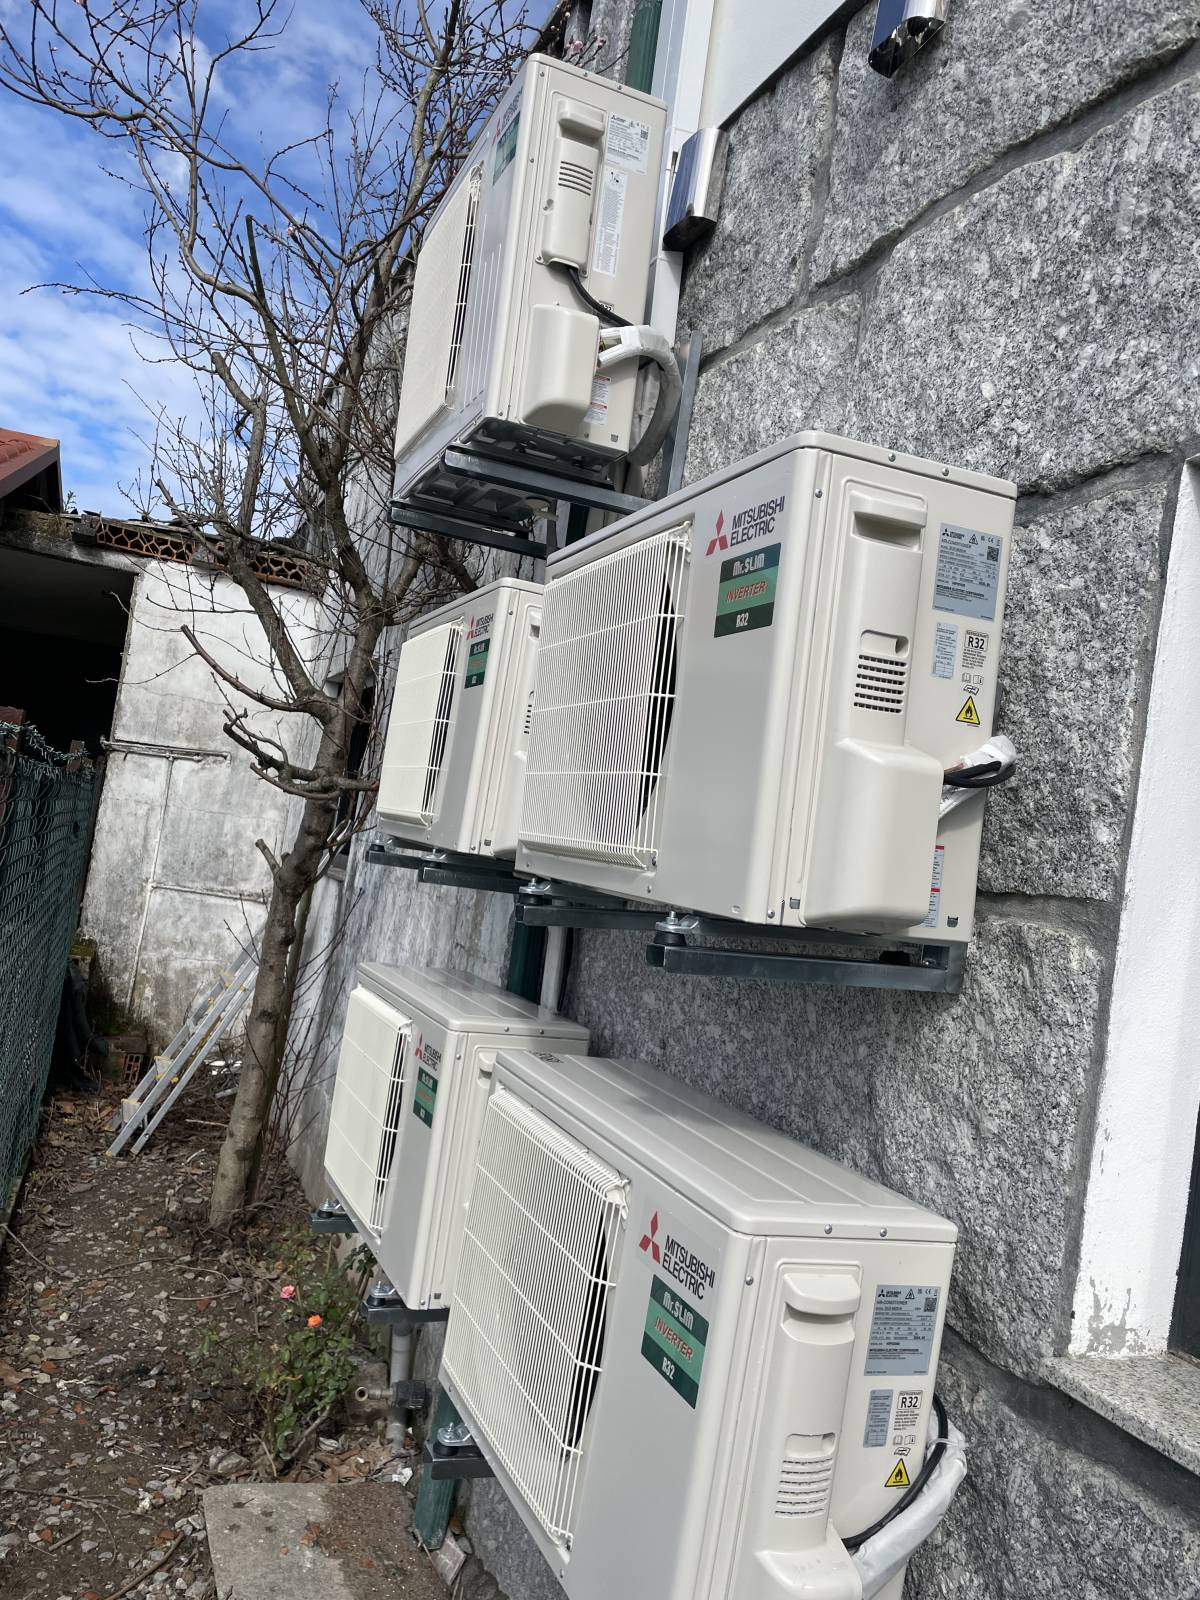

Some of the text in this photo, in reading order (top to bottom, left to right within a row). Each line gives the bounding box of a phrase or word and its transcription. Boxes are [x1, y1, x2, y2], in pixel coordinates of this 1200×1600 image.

[732, 496, 785, 530] MITSUBISHI
[730, 517, 775, 547] ELECTRIC
[727, 580, 768, 603] INVERTER
[736, 612, 749, 628] R32
[968, 636, 985, 649] R32
[665, 1235, 716, 1289] MITSUBISHI
[662, 1255, 705, 1300] ELECTRIC
[655, 1317, 694, 1361] INVERTER
[662, 1357, 675, 1380] R32
[900, 1396, 919, 1408] R32
